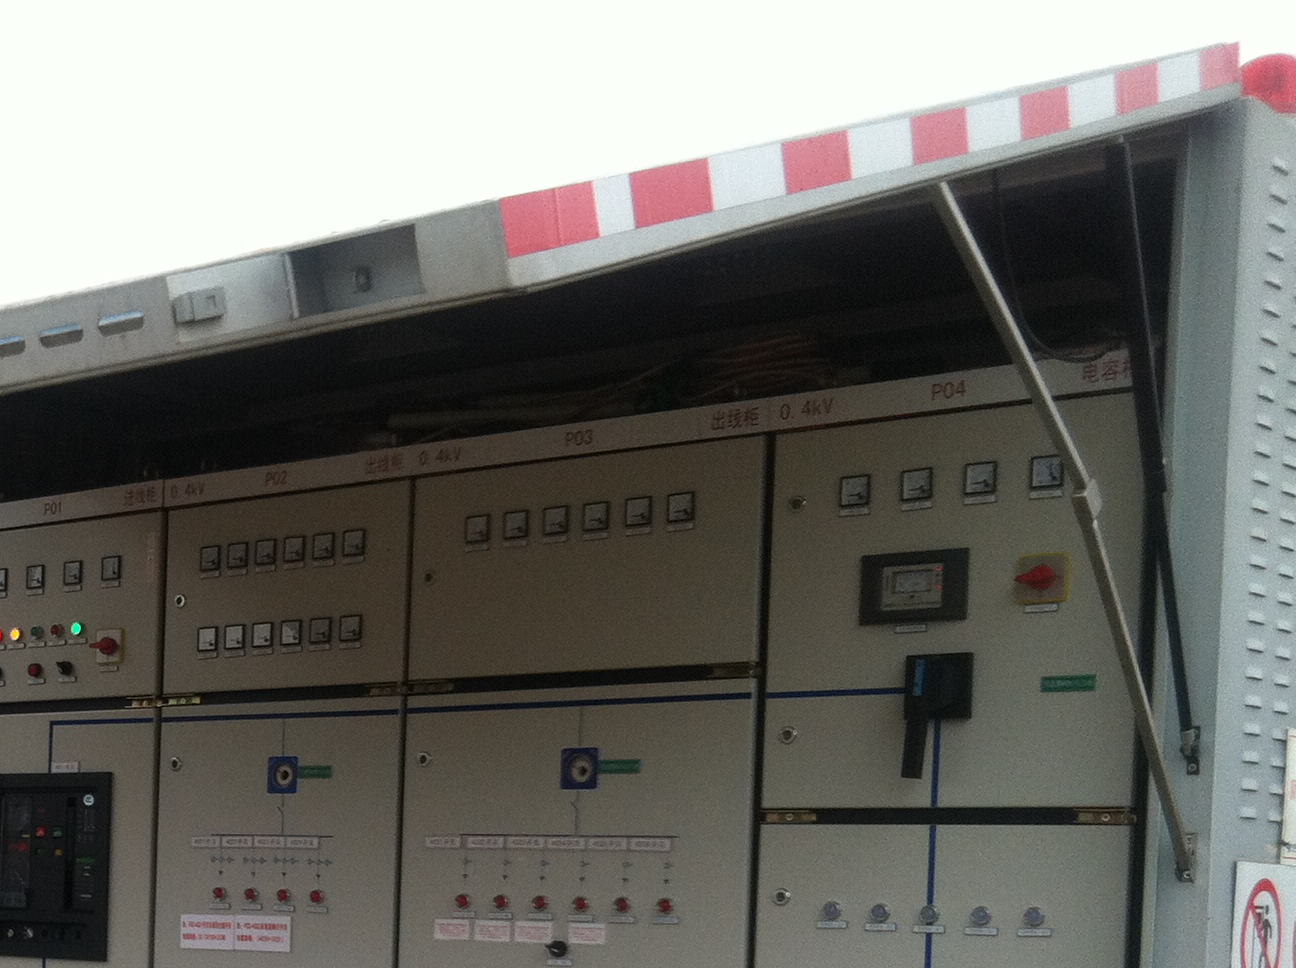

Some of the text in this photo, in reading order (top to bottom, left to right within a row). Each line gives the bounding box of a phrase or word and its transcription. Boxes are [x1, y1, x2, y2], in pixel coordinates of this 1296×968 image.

[930, 379, 967, 400] P04
[1081, 357, 1132, 384] 电容
[564, 429, 594, 447] P03
[711, 406, 759, 431] 出线柜
[264, 470, 288, 487] P02
[44, 502, 63, 515] P01
